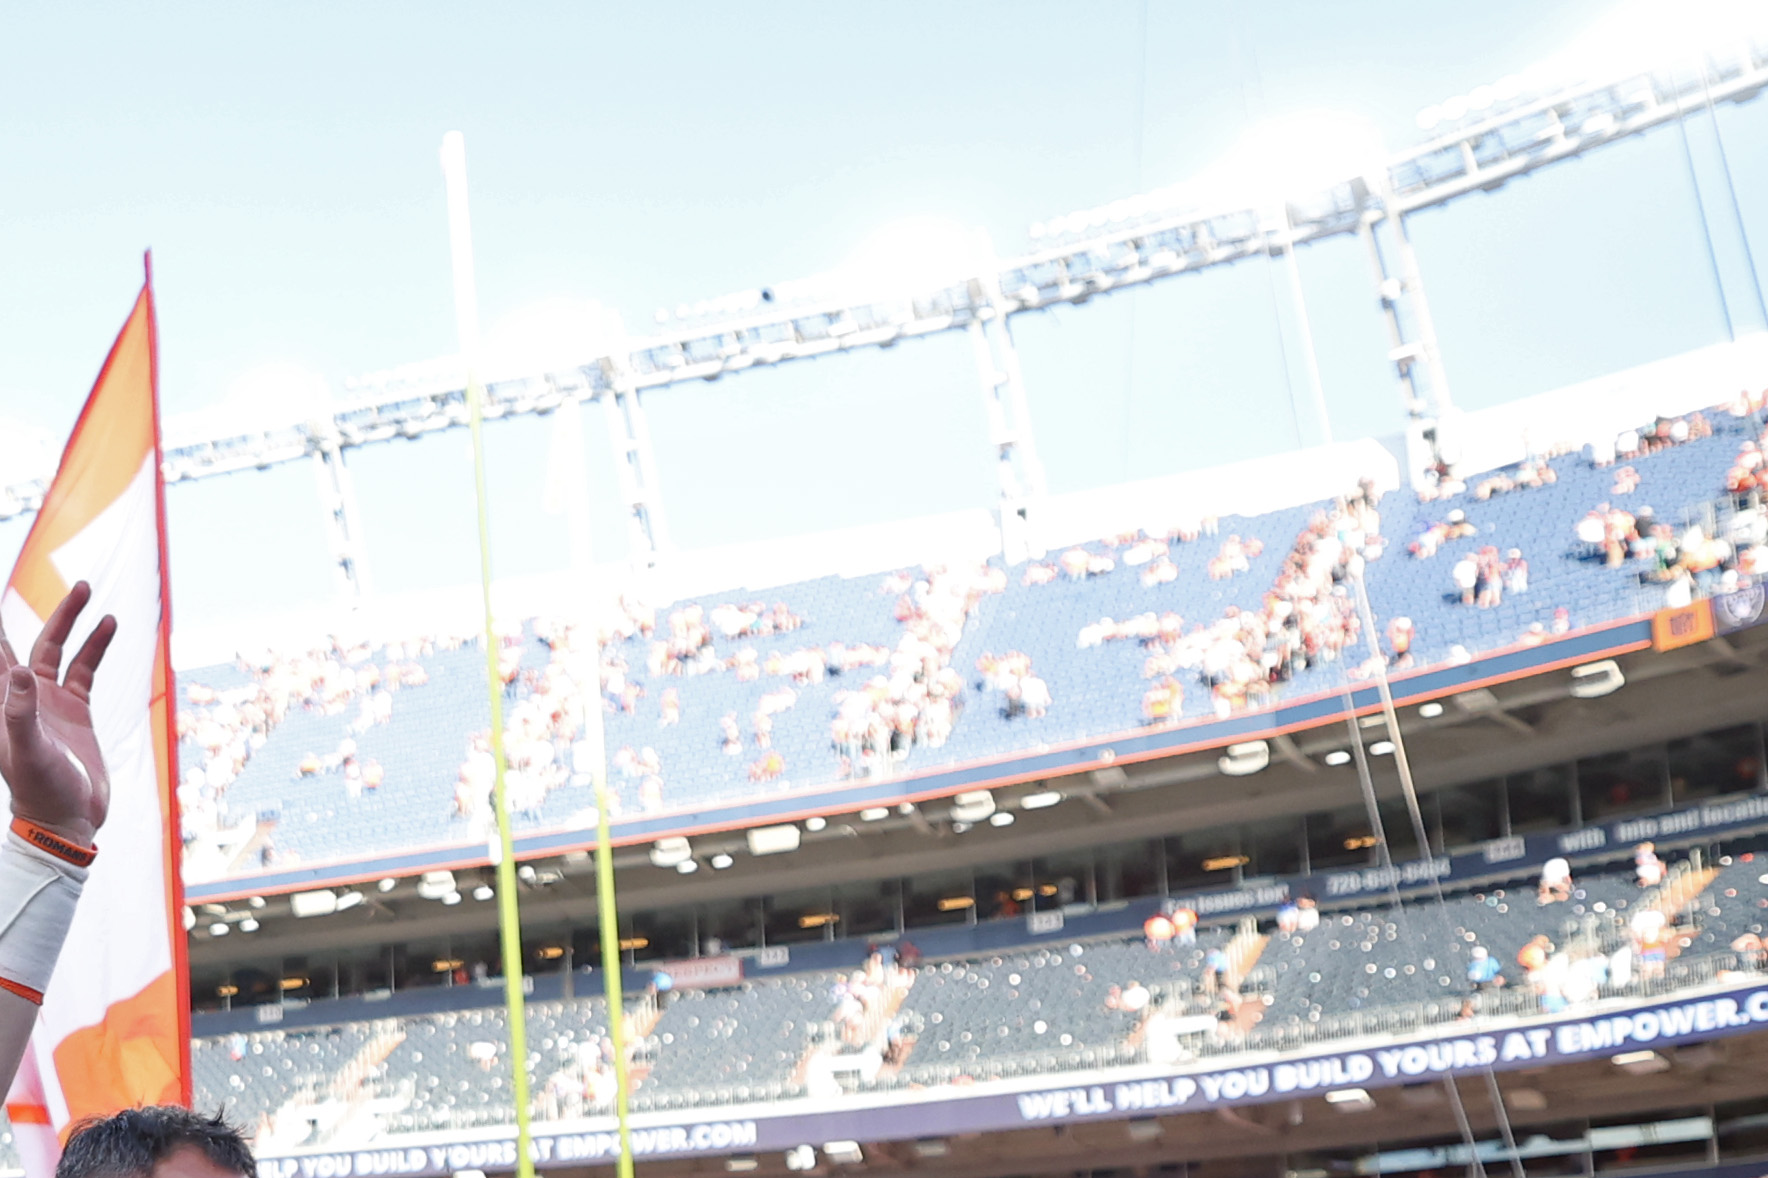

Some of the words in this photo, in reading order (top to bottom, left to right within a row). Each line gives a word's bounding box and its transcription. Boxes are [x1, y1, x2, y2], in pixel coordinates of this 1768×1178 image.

[1016, 1086, 1113, 1120] WE'LL
[1114, 1077, 1197, 1110] HELP
[1199, 1068, 1270, 1102] YOU
[1273, 1055, 1373, 1092] BUILD
[1376, 1036, 1498, 1078] YOURS
[1500, 1029, 1552, 1062] AT
[300, 1153, 352, 1178] YOU
[353, 1147, 428, 1176] BUILD
[431, 1139, 518, 1170] YOURS
